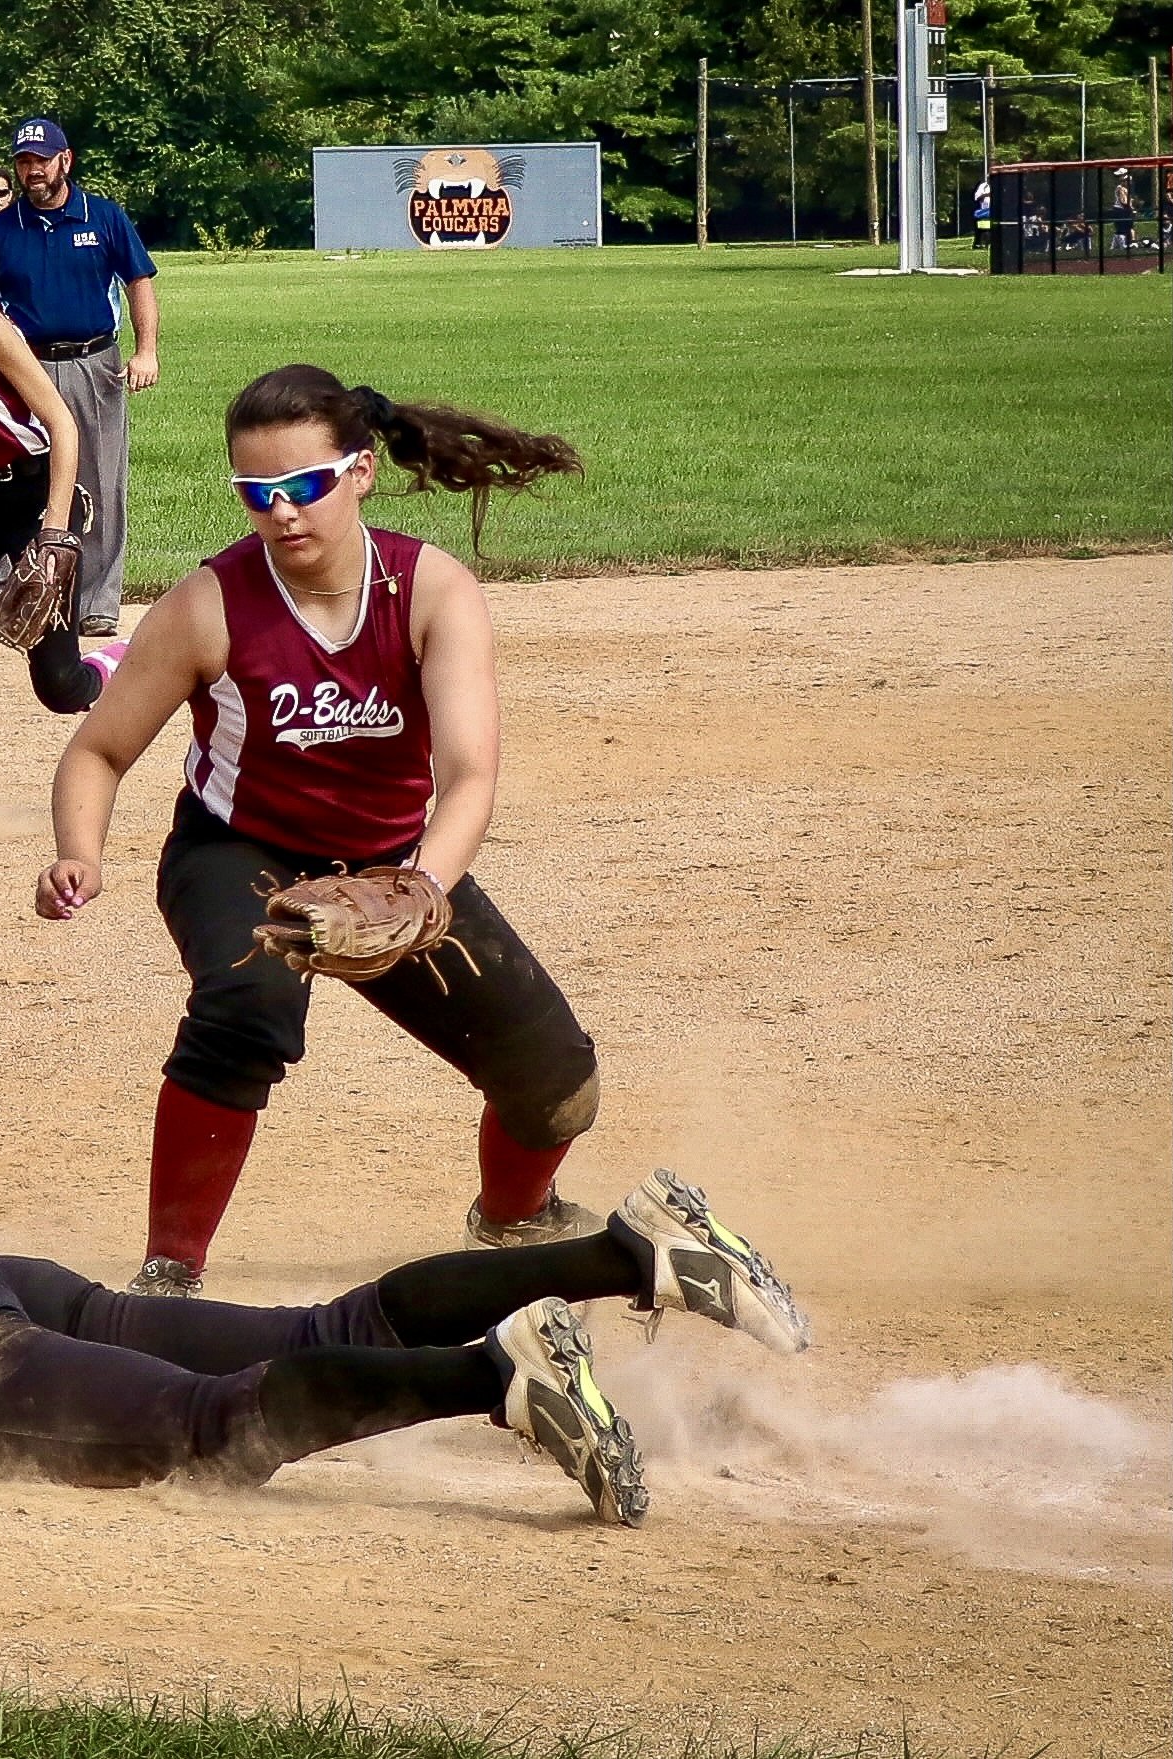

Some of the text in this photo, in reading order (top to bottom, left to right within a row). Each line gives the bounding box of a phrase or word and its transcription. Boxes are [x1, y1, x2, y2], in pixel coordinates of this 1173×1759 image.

[18, 125, 45, 139] USA
[413, 198, 510, 217] PALMYRA
[422, 216, 500, 233] COUGARS
[73, 231, 97, 241] USA
[270, 681, 389, 727] D-Backs
[299, 726, 355, 742] SOFTBALL
